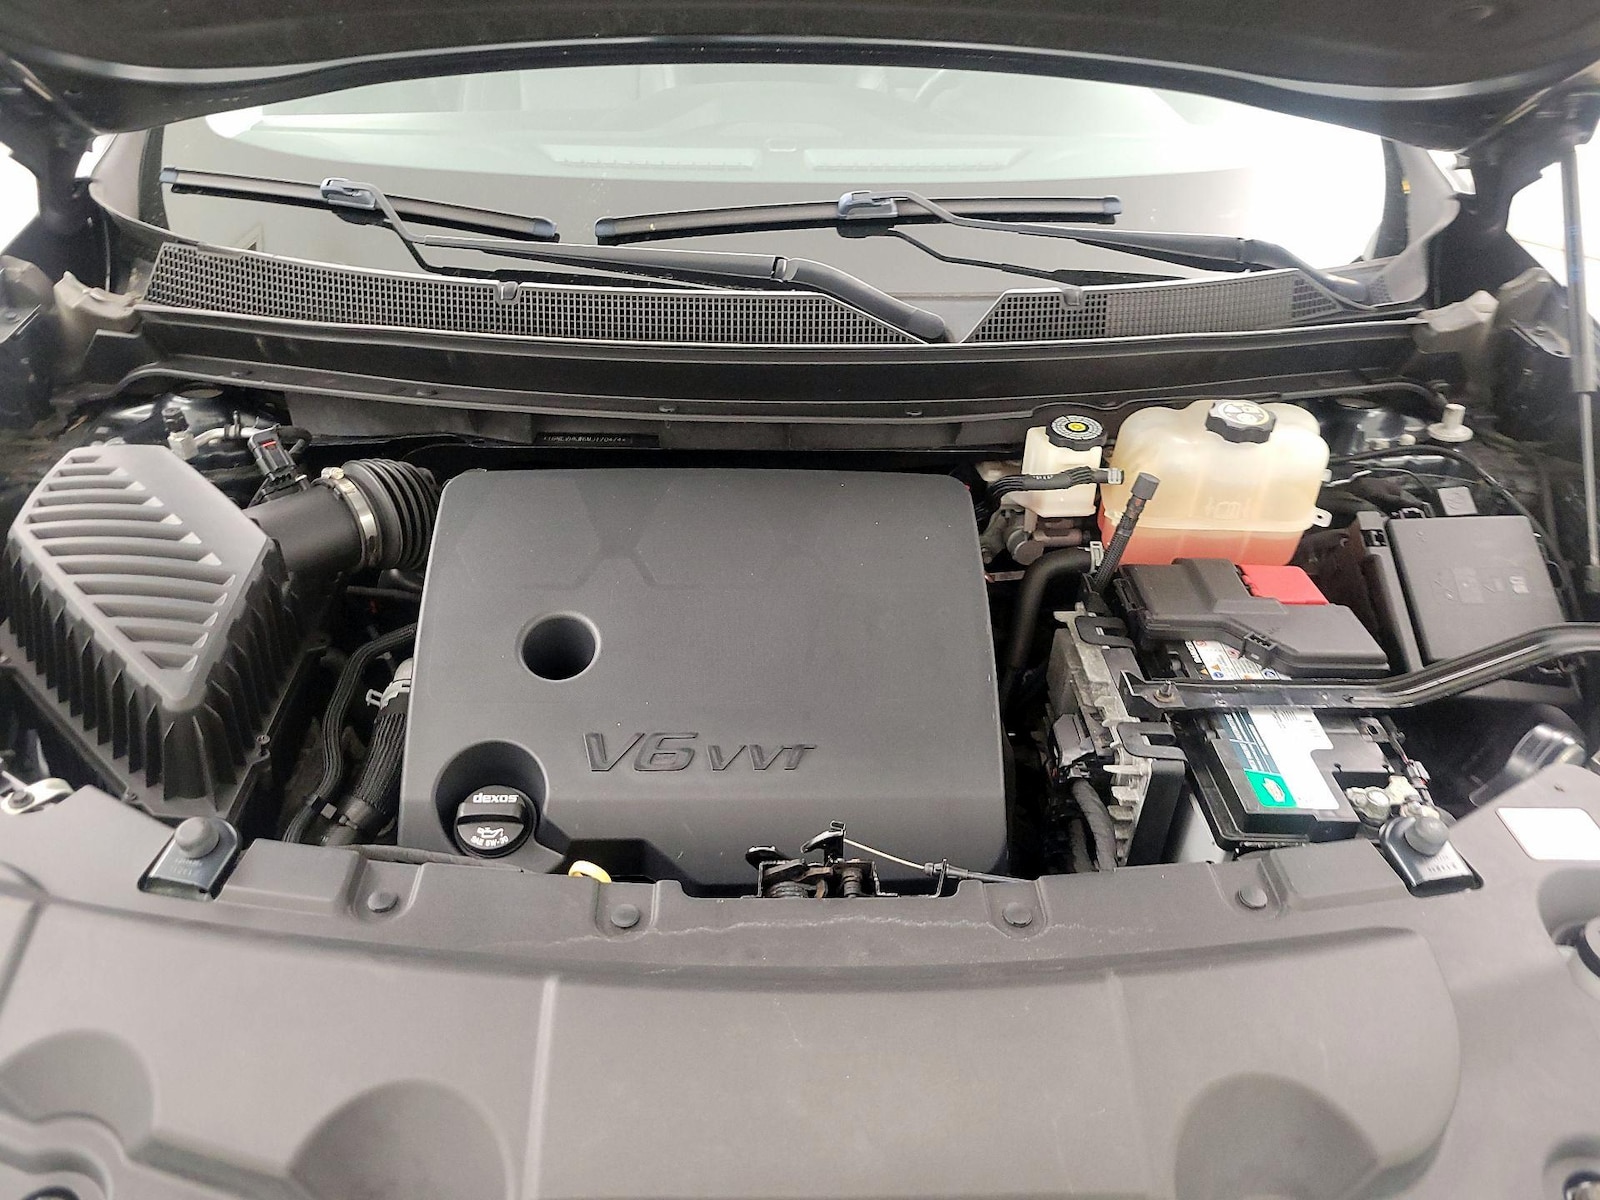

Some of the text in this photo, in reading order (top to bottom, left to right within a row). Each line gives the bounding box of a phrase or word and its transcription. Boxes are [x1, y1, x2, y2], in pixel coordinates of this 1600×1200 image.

[583, 732, 818, 772] V6 VVT
[472, 792, 520, 804] dexos
[470, 835, 509, 847] SAE 5W-30
